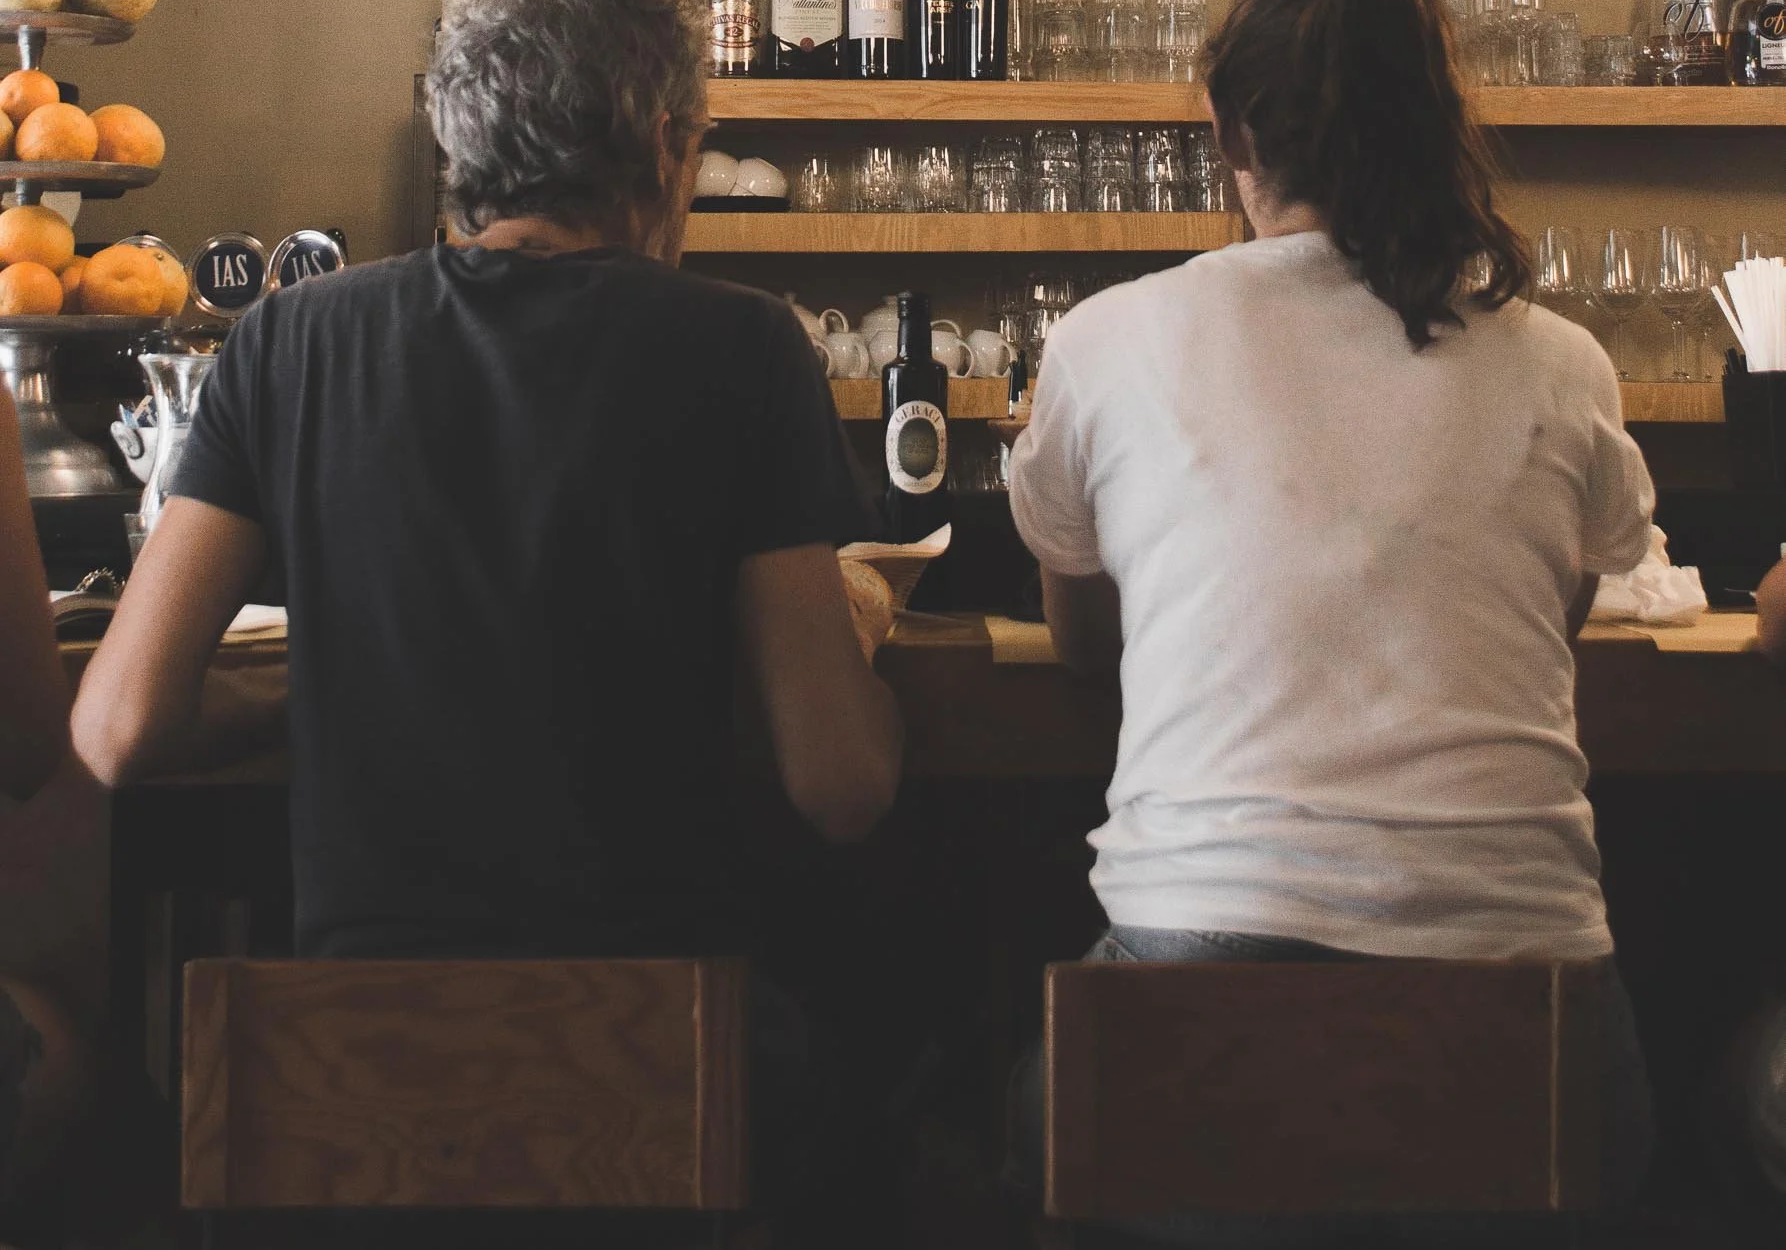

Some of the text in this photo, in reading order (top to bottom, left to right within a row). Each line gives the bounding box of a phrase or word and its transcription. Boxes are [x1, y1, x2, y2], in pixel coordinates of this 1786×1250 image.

[736, 14, 759, 29] REGAL
[212, 253, 249, 288] IAS
[292, 250, 324, 281] IAS
[895, 405, 942, 423] GERACI
